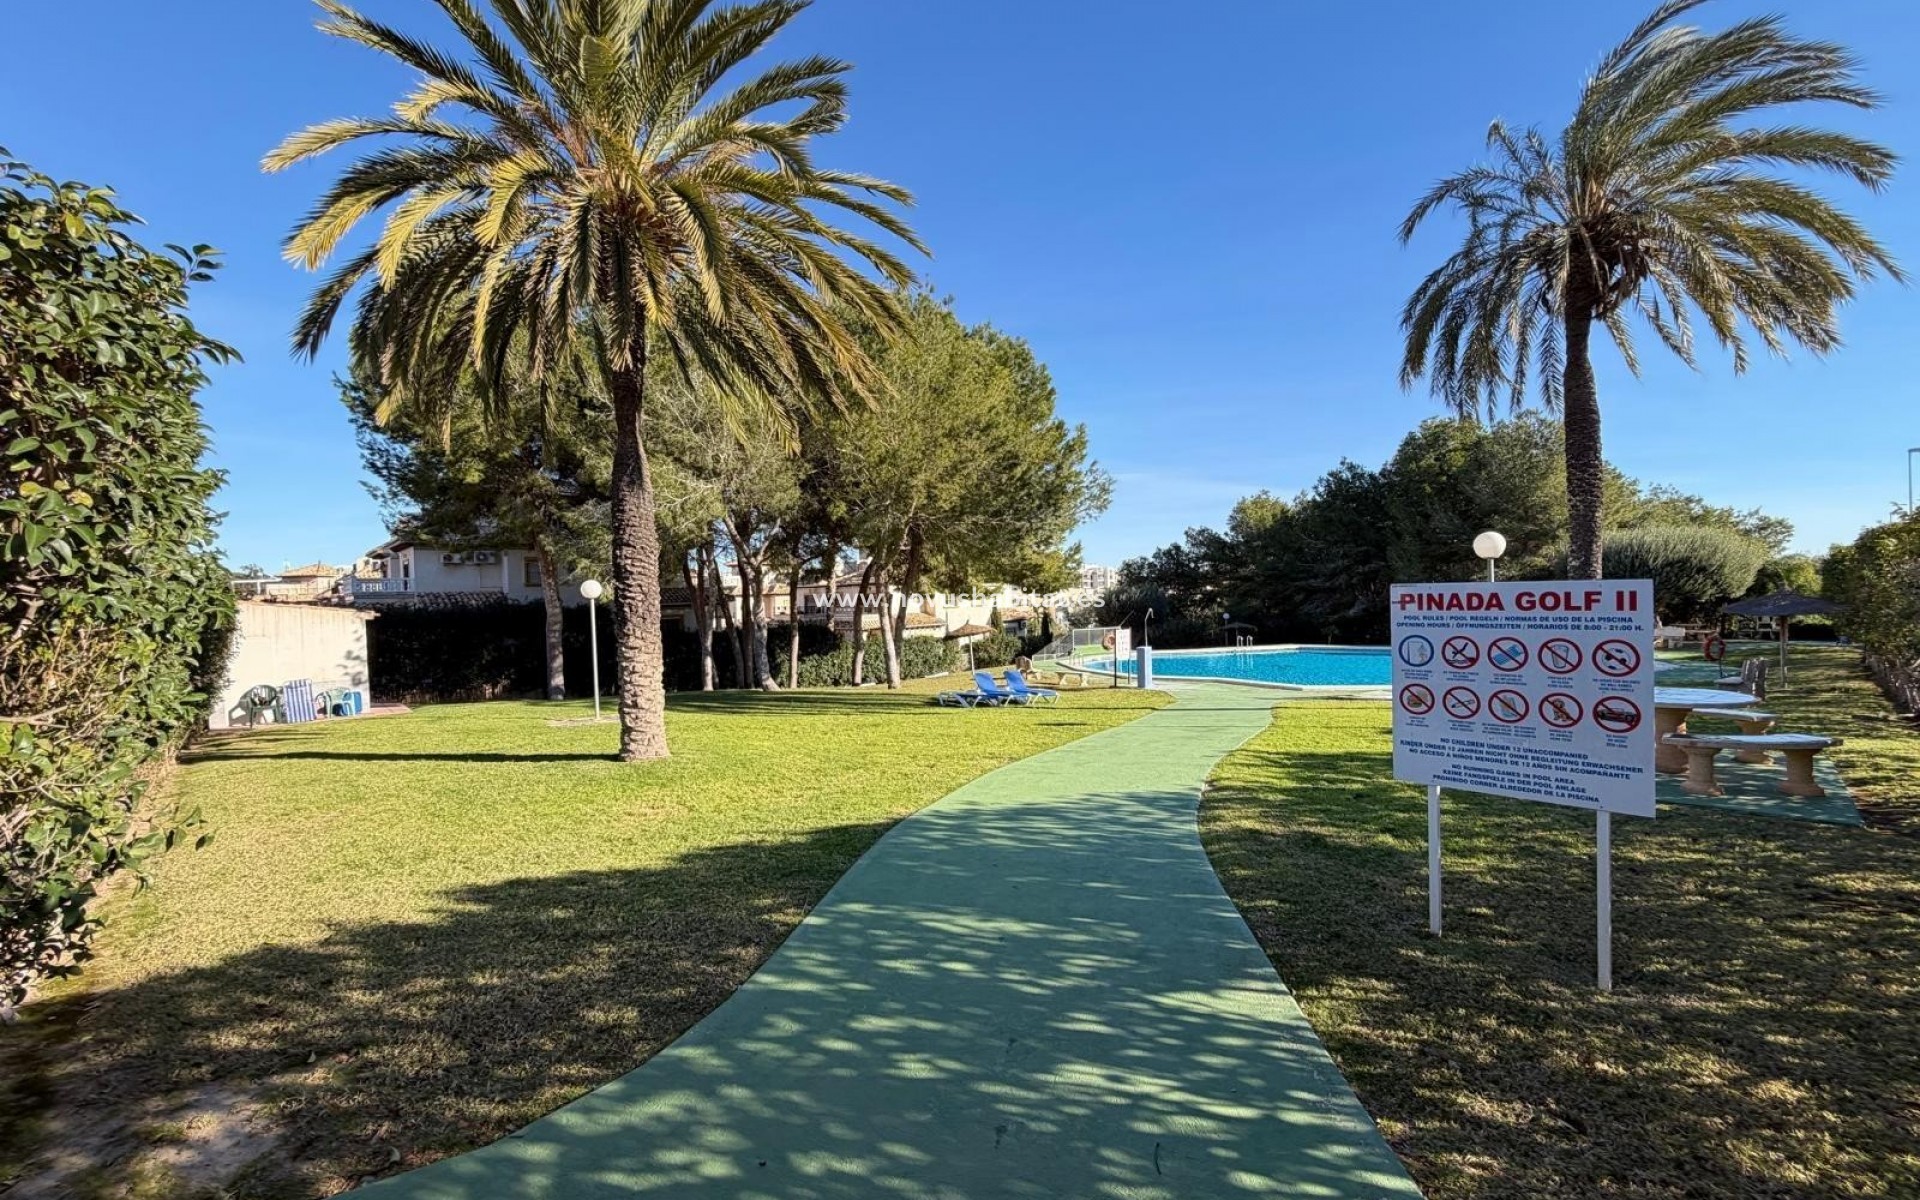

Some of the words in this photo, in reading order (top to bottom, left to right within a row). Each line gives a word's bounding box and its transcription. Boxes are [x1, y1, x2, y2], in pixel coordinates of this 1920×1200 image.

[1400, 591, 1504, 612] PINADA
[1515, 591, 1602, 612] GOLF
[1616, 590, 1637, 612] II
[1400, 740, 1423, 748] KINDER
[1452, 738, 1485, 748] CHILDREN
[1486, 742, 1511, 751] UNDER
[1420, 749, 1445, 757] ACCESO
[1474, 755, 1508, 765] MENORES
[1443, 769, 1463, 777] KEINE
[1533, 781, 1553, 789] POOL
[1555, 784, 1586, 793] ANLAGE
[1496, 769, 1521, 778] GAMES
[1533, 774, 1552, 782] POOL
[1554, 777, 1575, 785] AREA
[1433, 774, 1469, 784] PROHIBIDO
[1469, 779, 1498, 788] CORRER
[1567, 793, 1599, 803] PISCINA
